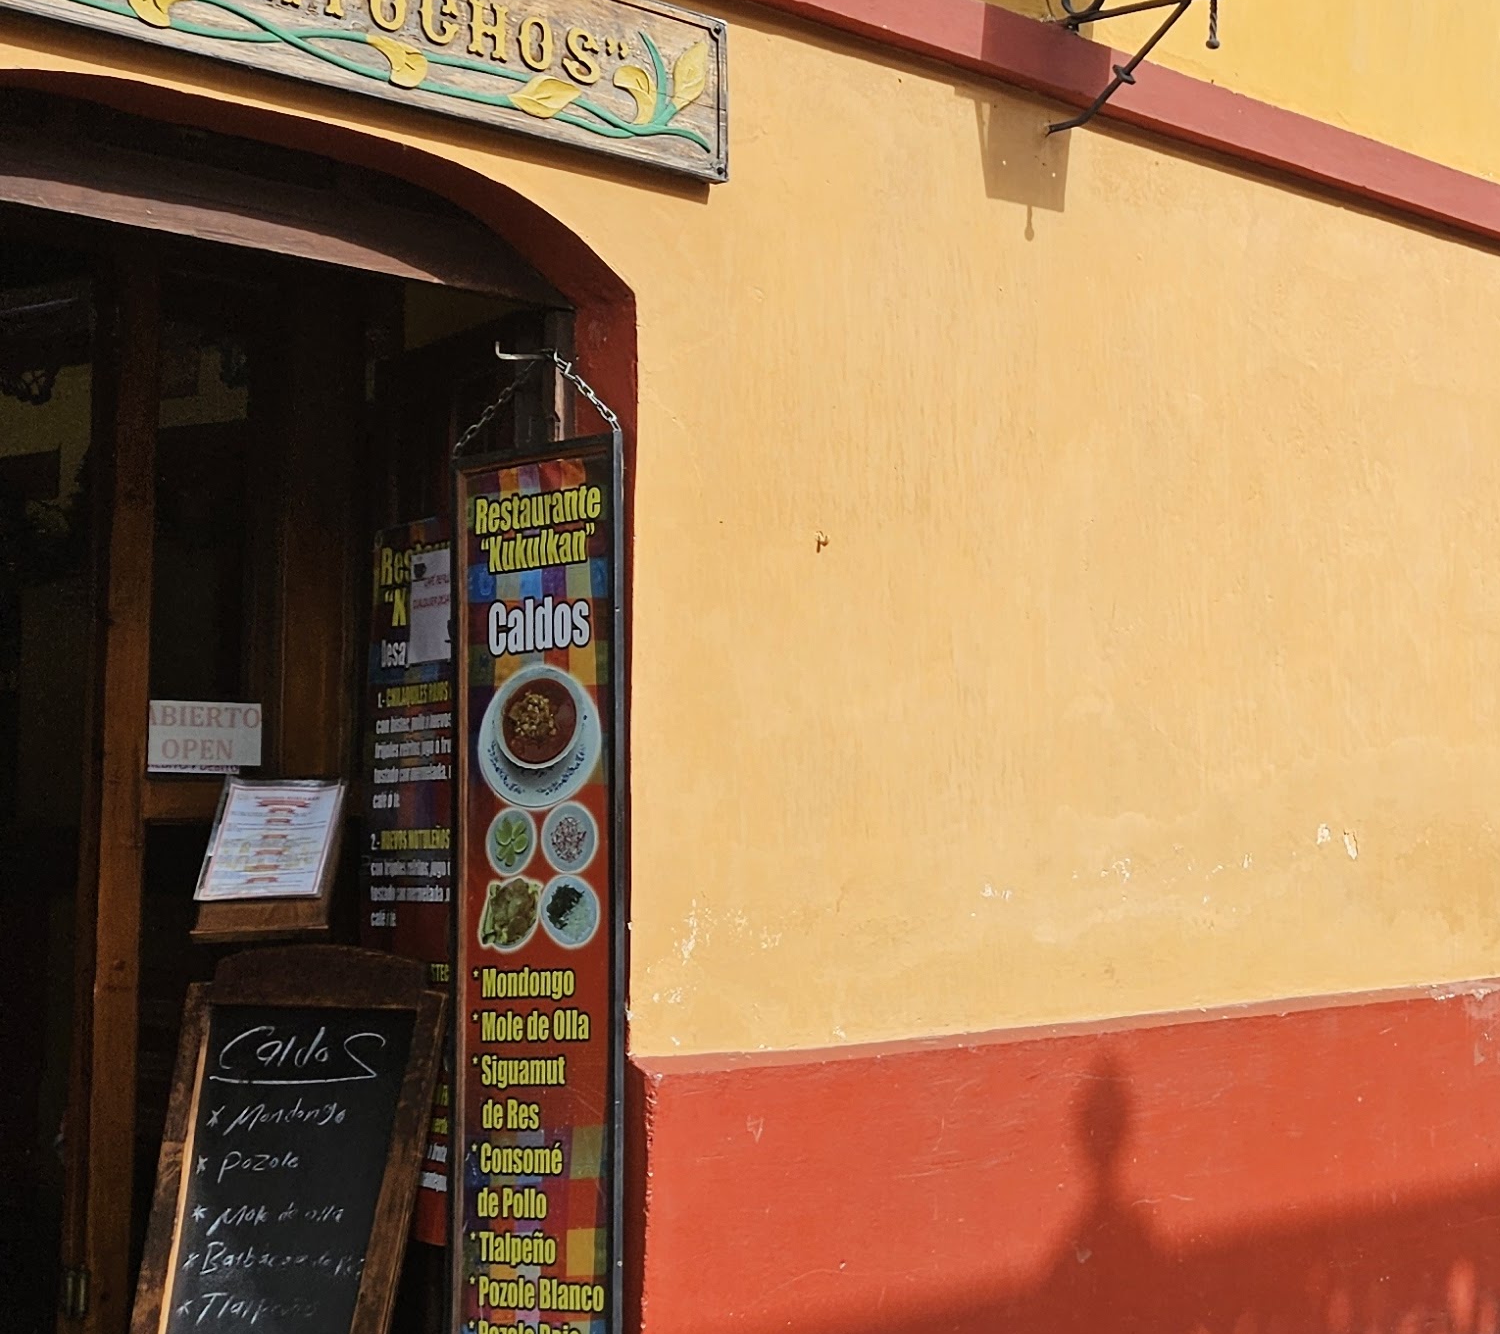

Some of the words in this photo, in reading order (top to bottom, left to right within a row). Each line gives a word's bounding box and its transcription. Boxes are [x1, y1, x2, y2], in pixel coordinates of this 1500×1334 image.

[475, 485, 601, 535] Restaurante
[488, 596, 590, 657] Caldos
[161, 738, 233, 760] OPEN
[481, 967, 575, 1000] Mondongo
[481, 1011, 523, 1042] Mole
[527, 1010, 549, 1041] de
[553, 1009, 590, 1041] Olla
[481, 1055, 566, 1089] Siguamut
[482, 1099, 503, 1130] de
[507, 1099, 540, 1130] Res
[480, 1142, 563, 1175] Consomé
[477, 1187, 499, 1218] de
[502, 1187, 547, 1219] Pollo
[479, 1231, 556, 1266] Tlalpeño
[478, 1275, 536, 1310] Pozole
[539, 1278, 605, 1312] Blanco
